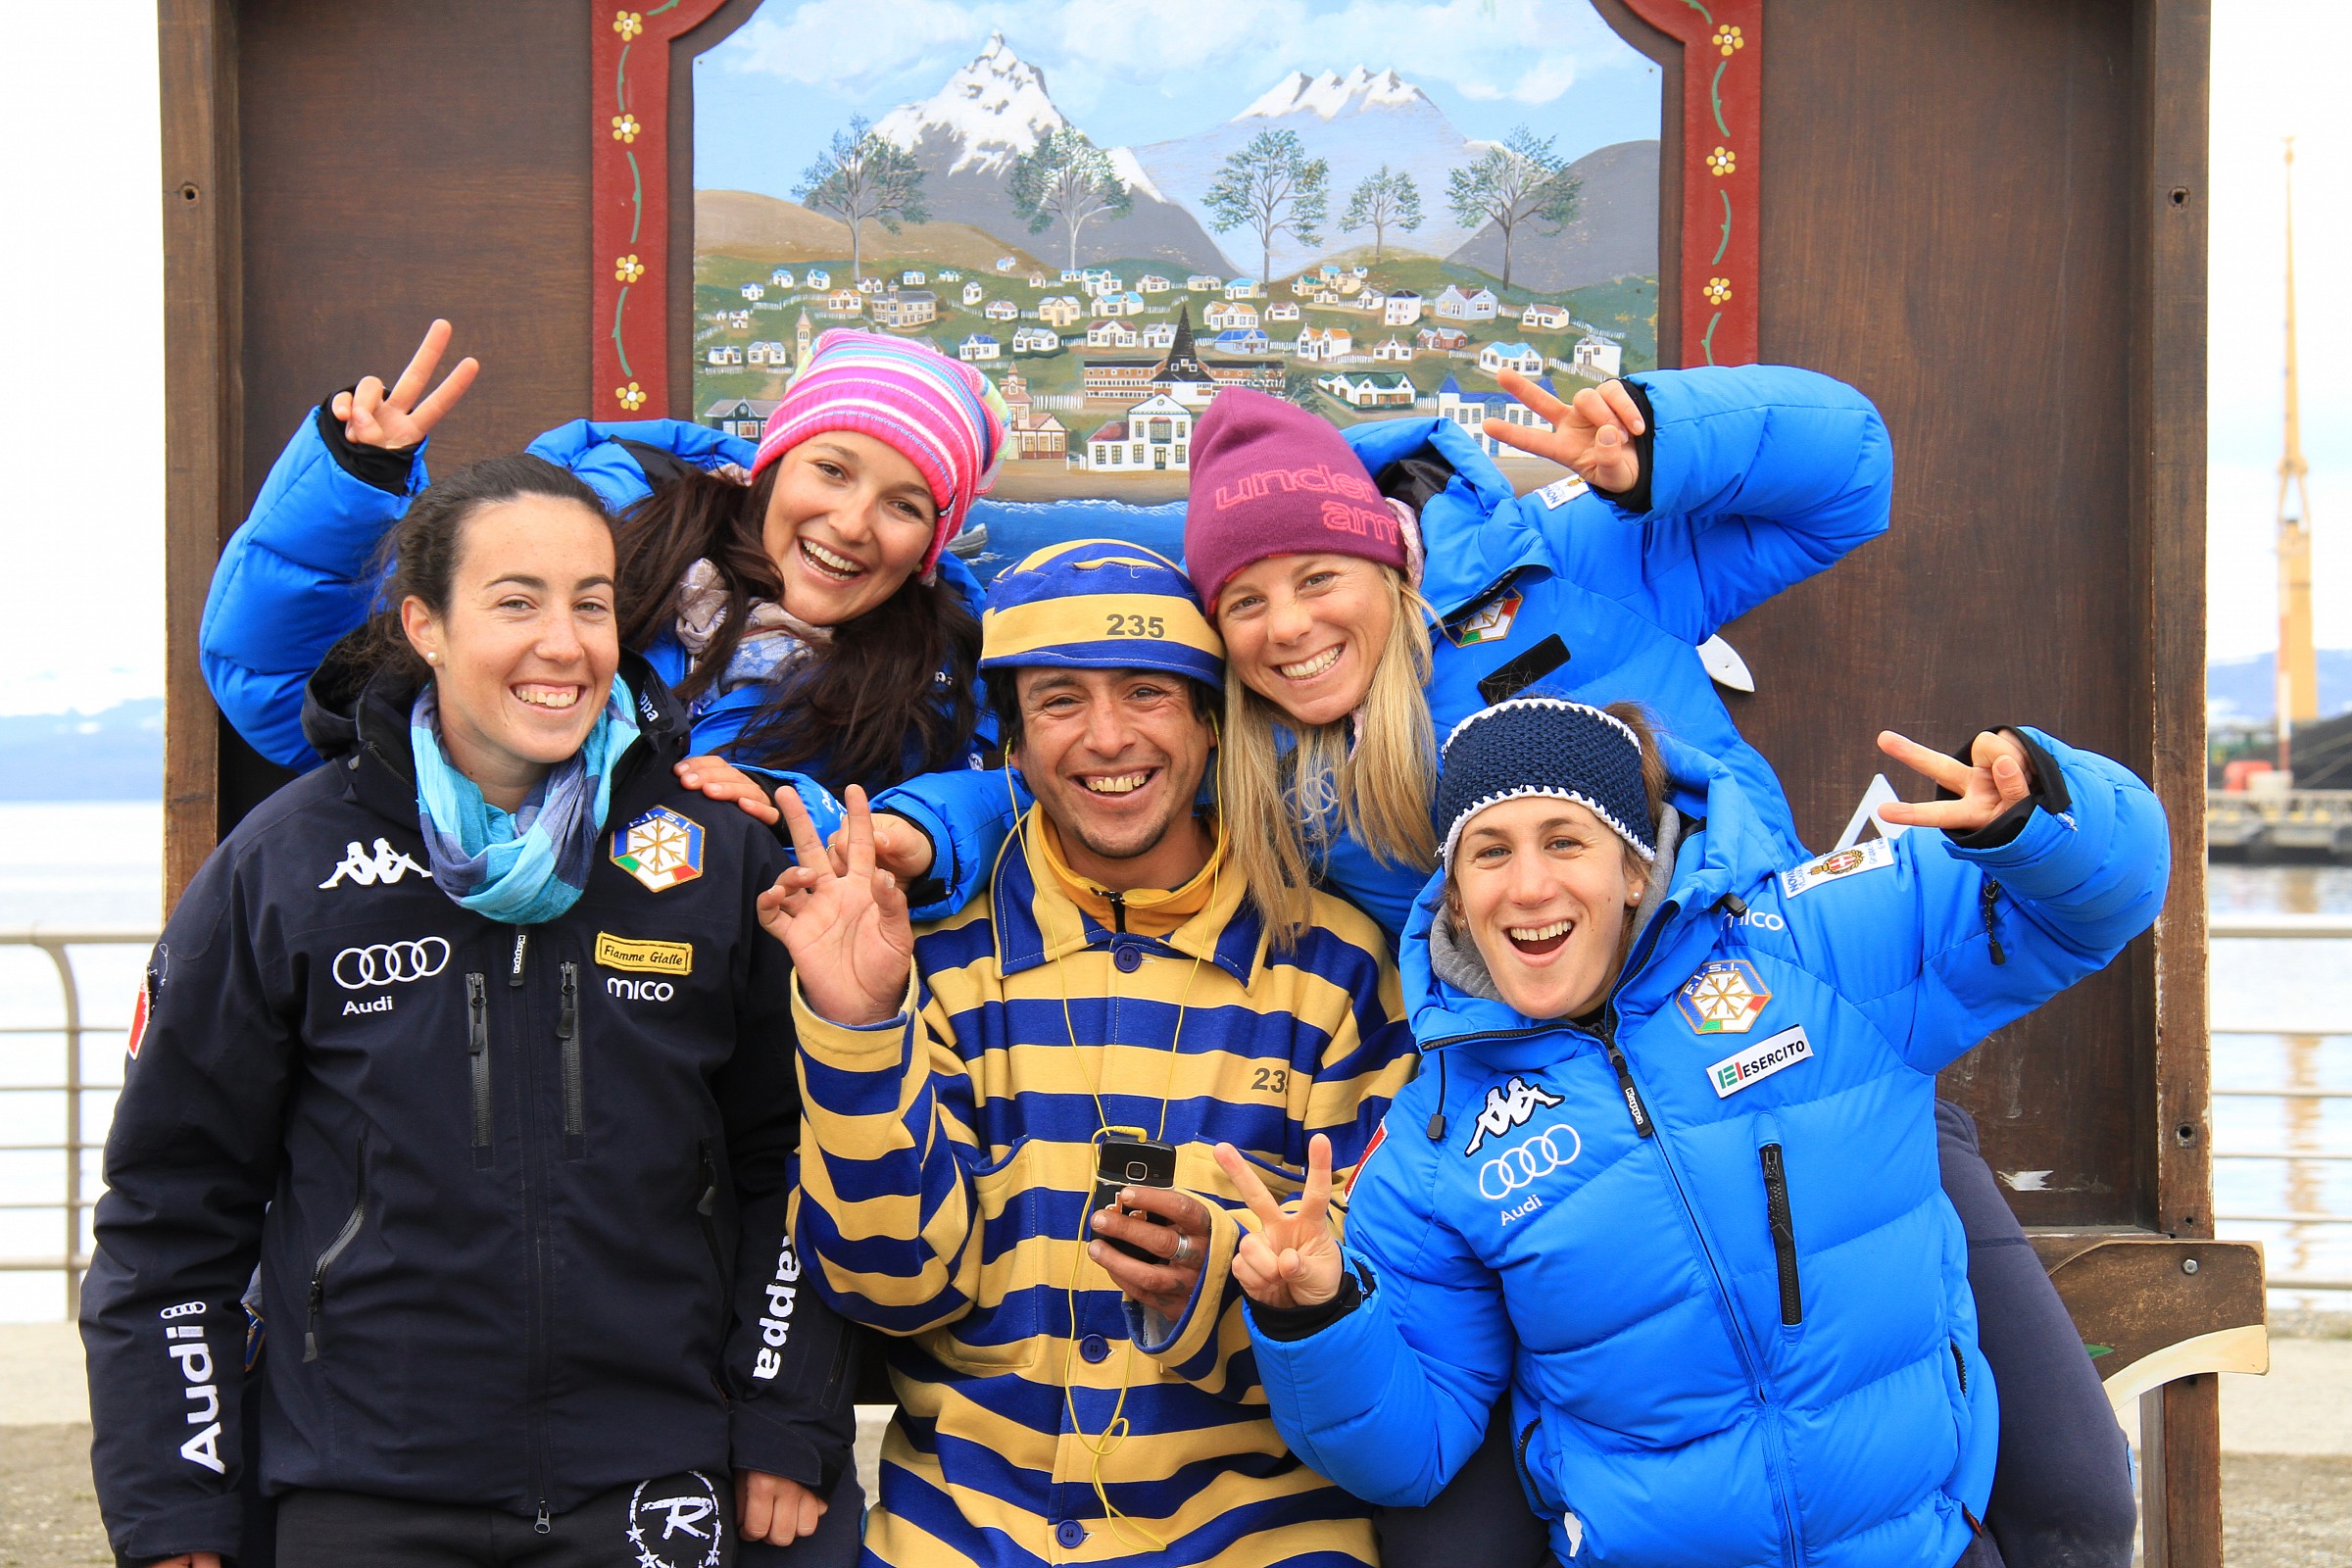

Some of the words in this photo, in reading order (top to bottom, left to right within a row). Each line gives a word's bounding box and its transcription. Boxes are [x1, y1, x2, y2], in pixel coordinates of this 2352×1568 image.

[1105, 613, 1165, 639] 235
[513, 934, 526, 974] Kappa
[604, 945, 645, 962] Fiamme
[342, 996, 393, 1016] Audi
[1742, 1040, 1805, 1078] ESERCITO
[1250, 1067, 1288, 1094] 23
[1625, 1087, 1643, 1125] Kappa
[1500, 1194, 1543, 1227] Audi
[753, 1235, 802, 1381] appa
[166, 1326, 225, 1475] Audi
